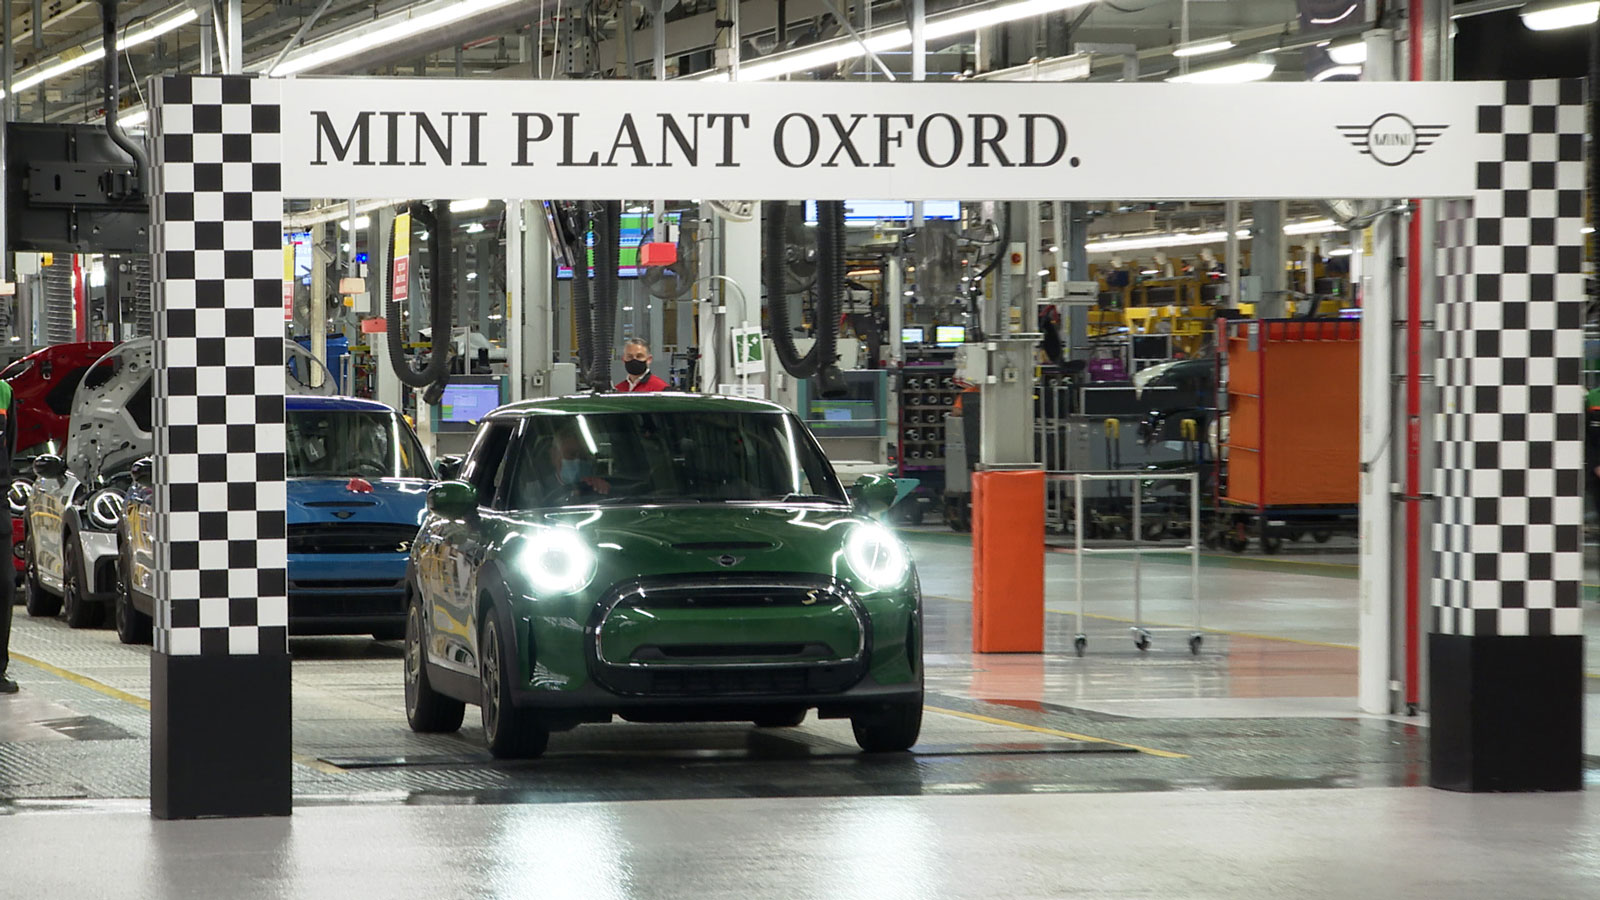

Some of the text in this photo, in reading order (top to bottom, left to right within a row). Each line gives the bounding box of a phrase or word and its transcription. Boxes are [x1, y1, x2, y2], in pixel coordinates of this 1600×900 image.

[310, 110, 1081, 169] MINI PLANT OXFORD.
[1373, 133, 1412, 146] MINI
[802, 590, 819, 605] S
